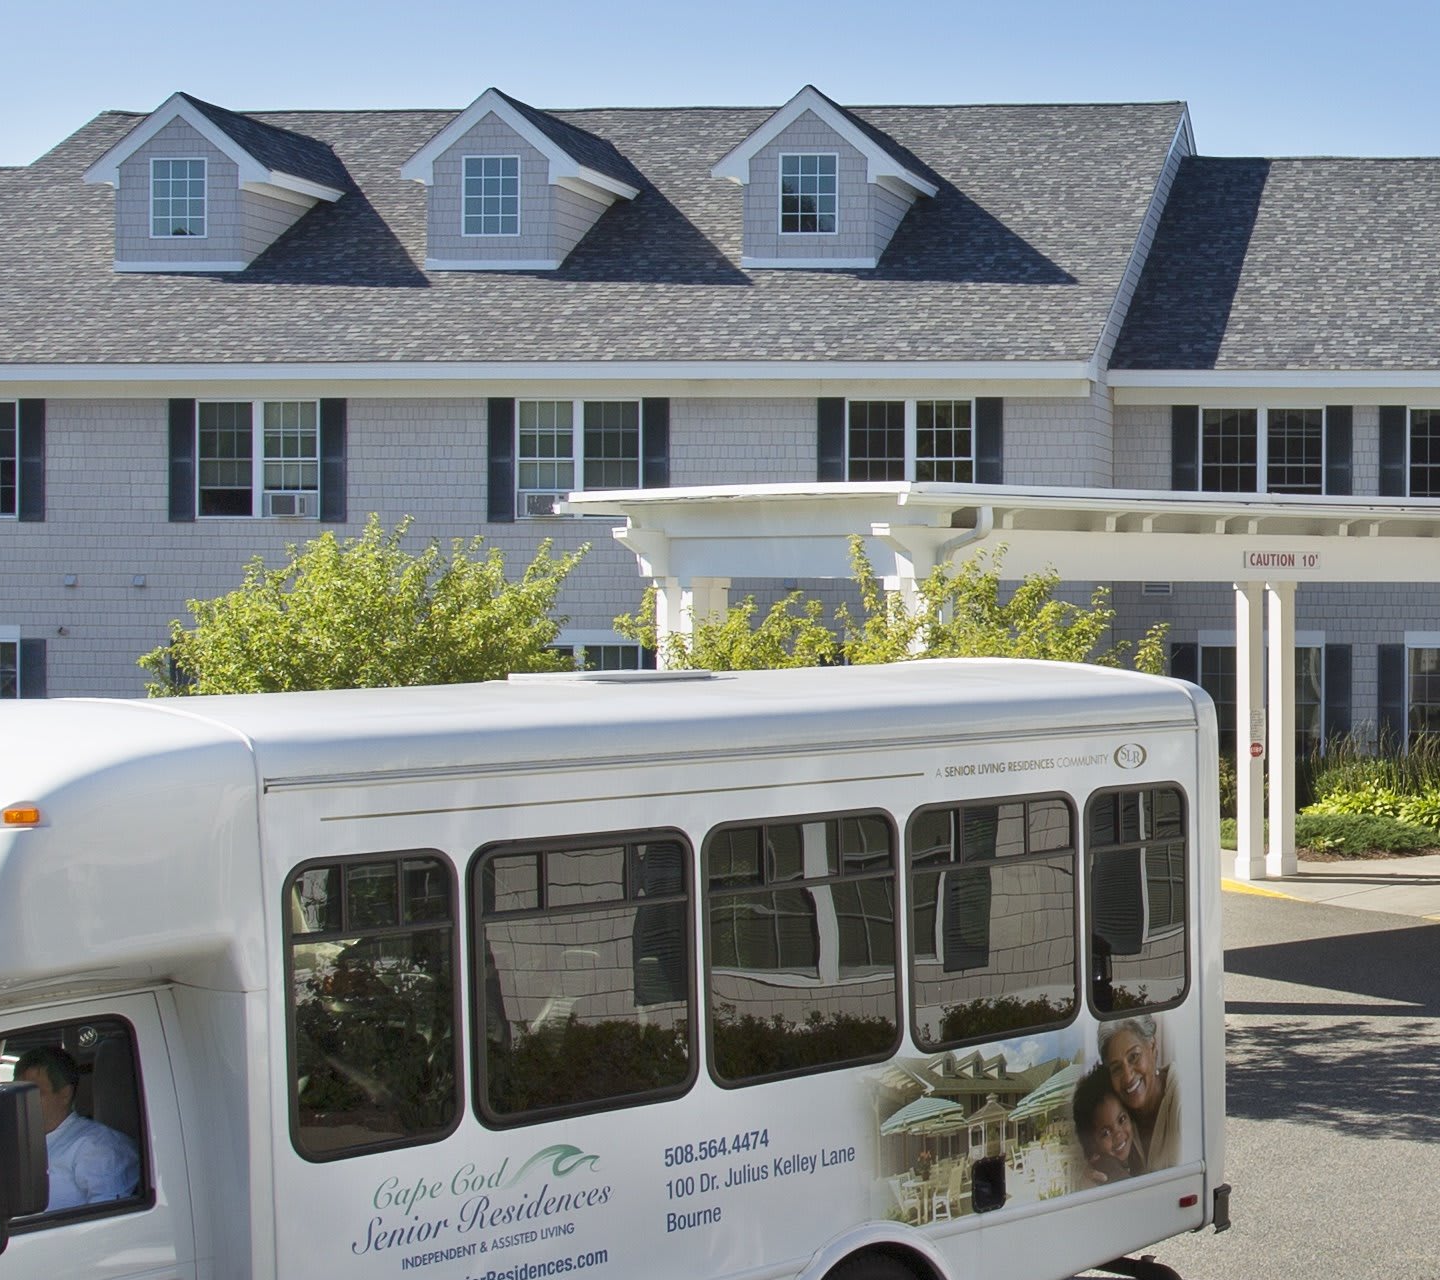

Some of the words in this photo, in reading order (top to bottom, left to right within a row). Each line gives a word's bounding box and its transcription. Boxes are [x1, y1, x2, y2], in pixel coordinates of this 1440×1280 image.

[1250, 553, 1295, 566] CAUTION
[1302, 554, 1318, 567] 10'
[935, 768, 943, 778] A
[944, 765, 976, 778] SENIOR
[977, 762, 1006, 775] LIVING
[1007, 758, 1055, 772] RESIDENCES
[1056, 754, 1109, 769] COMMUNITY
[1120, 747, 1141, 763] SLR
[664, 1129, 769, 1167] 508.564.4474
[373, 1176, 443, 1216] Cape
[450, 1157, 510, 1196] Cod
[665, 1176, 695, 1200] 100
[700, 1172, 720, 1193] Dr.
[724, 1163, 769, 1188] Julius
[773, 1153, 817, 1177] Kelley
[821, 1146, 856, 1167] Lane
[351, 1215, 449, 1256] Senior
[457, 1183, 613, 1233] Residences
[666, 1206, 722, 1233] Bourne
[401, 1243, 477, 1270] INDEPENDENT
[479, 1241, 488, 1253] &
[491, 1230, 538, 1252] ASSISTED
[540, 1222, 576, 1240] LIVING
